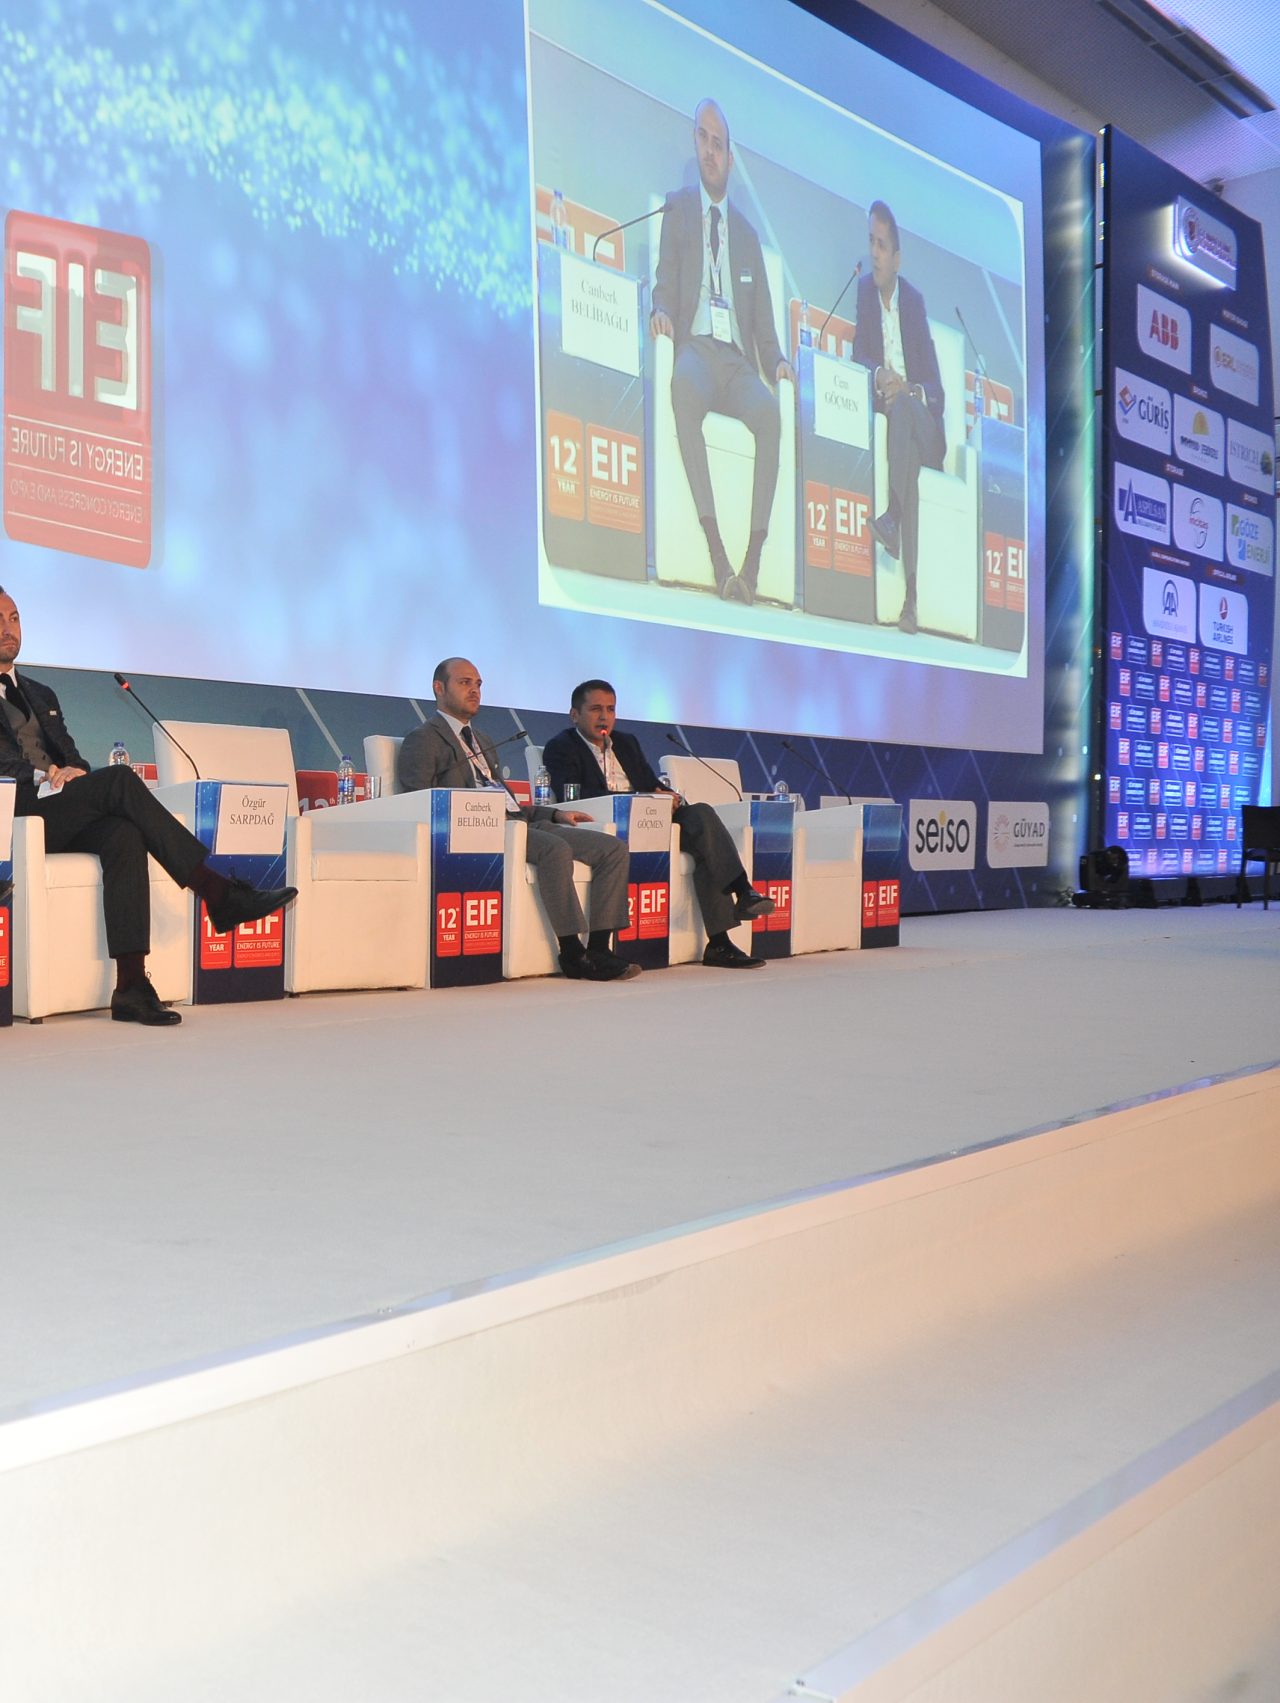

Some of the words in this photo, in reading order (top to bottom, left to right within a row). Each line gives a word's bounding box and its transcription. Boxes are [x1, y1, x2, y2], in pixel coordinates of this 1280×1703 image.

[1149, 309, 1179, 351] ABB
[1138, 395, 1169, 435] GÜRİŞ
[591, 435, 637, 486] EIF
[835, 498, 868, 538] EIF
[241, 795, 267, 810] Özgür
[464, 801, 492, 812] Canberk
[229, 812, 275, 826] SARPDAĞ
[457, 816, 499, 828] BELİBAĞLI
[1013, 818, 1046, 838] GÜYAD
[915, 810, 970, 854] seiso
[640, 888, 666, 914] EIF
[878, 885, 898, 905] EIF
[466, 899, 498, 926] EIF
[443, 933, 456, 941] YEAR
[209, 943, 225, 952] YEAR
